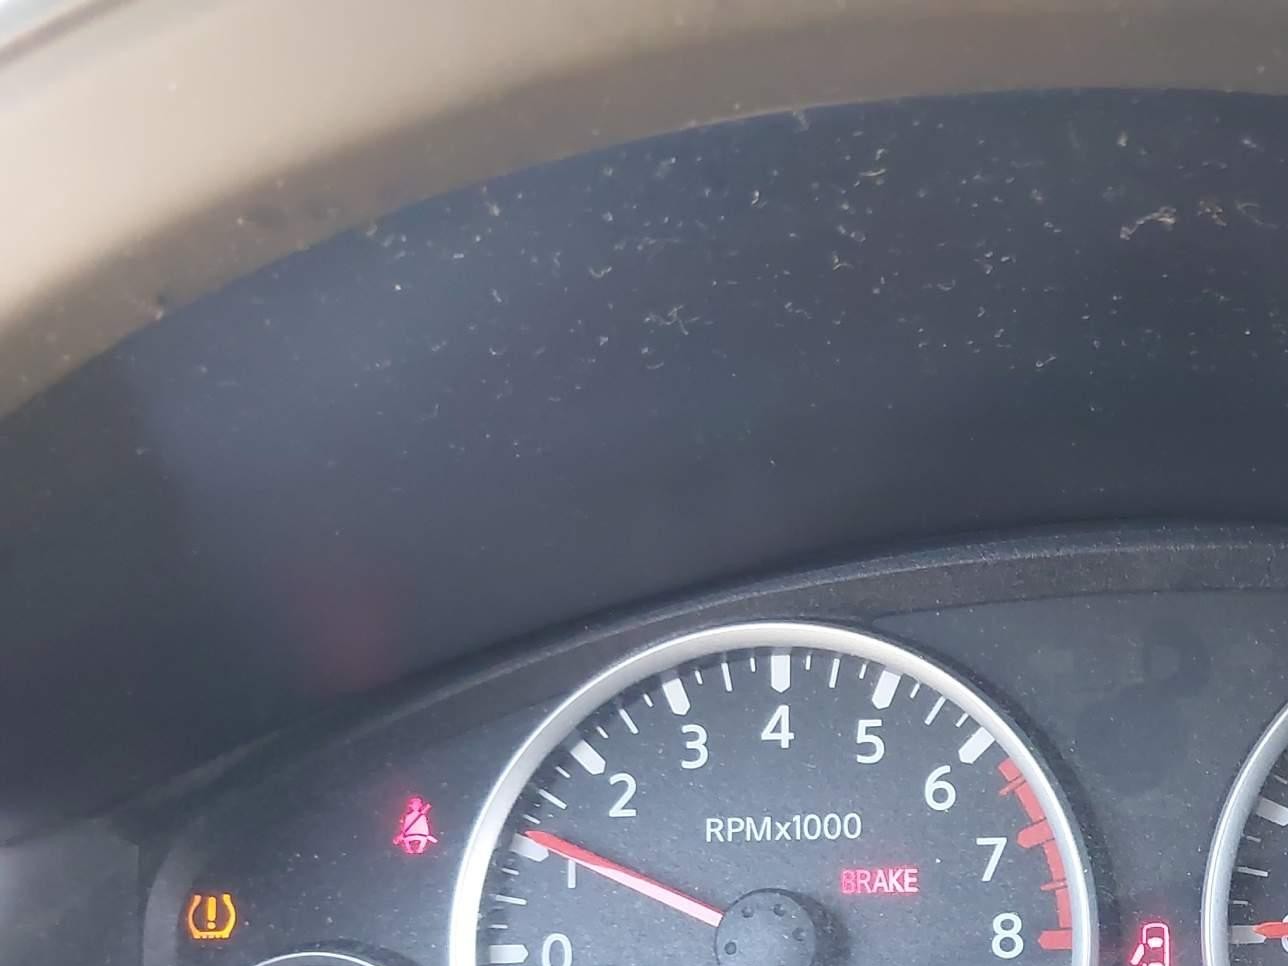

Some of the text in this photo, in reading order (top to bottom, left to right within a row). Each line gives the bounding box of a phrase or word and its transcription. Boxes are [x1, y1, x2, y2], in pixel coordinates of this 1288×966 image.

[681, 725, 709, 769] 3
[761, 706, 794, 748] 4
[856, 720, 885, 763] 5
[609, 774, 637, 818] 2
[924, 767, 956, 810] 6
[705, 814, 862, 843] RPMx1000
[977, 838, 1007, 881] 7
[841, 869, 919, 894] BRAKE
[991, 913, 1024, 959] 8
